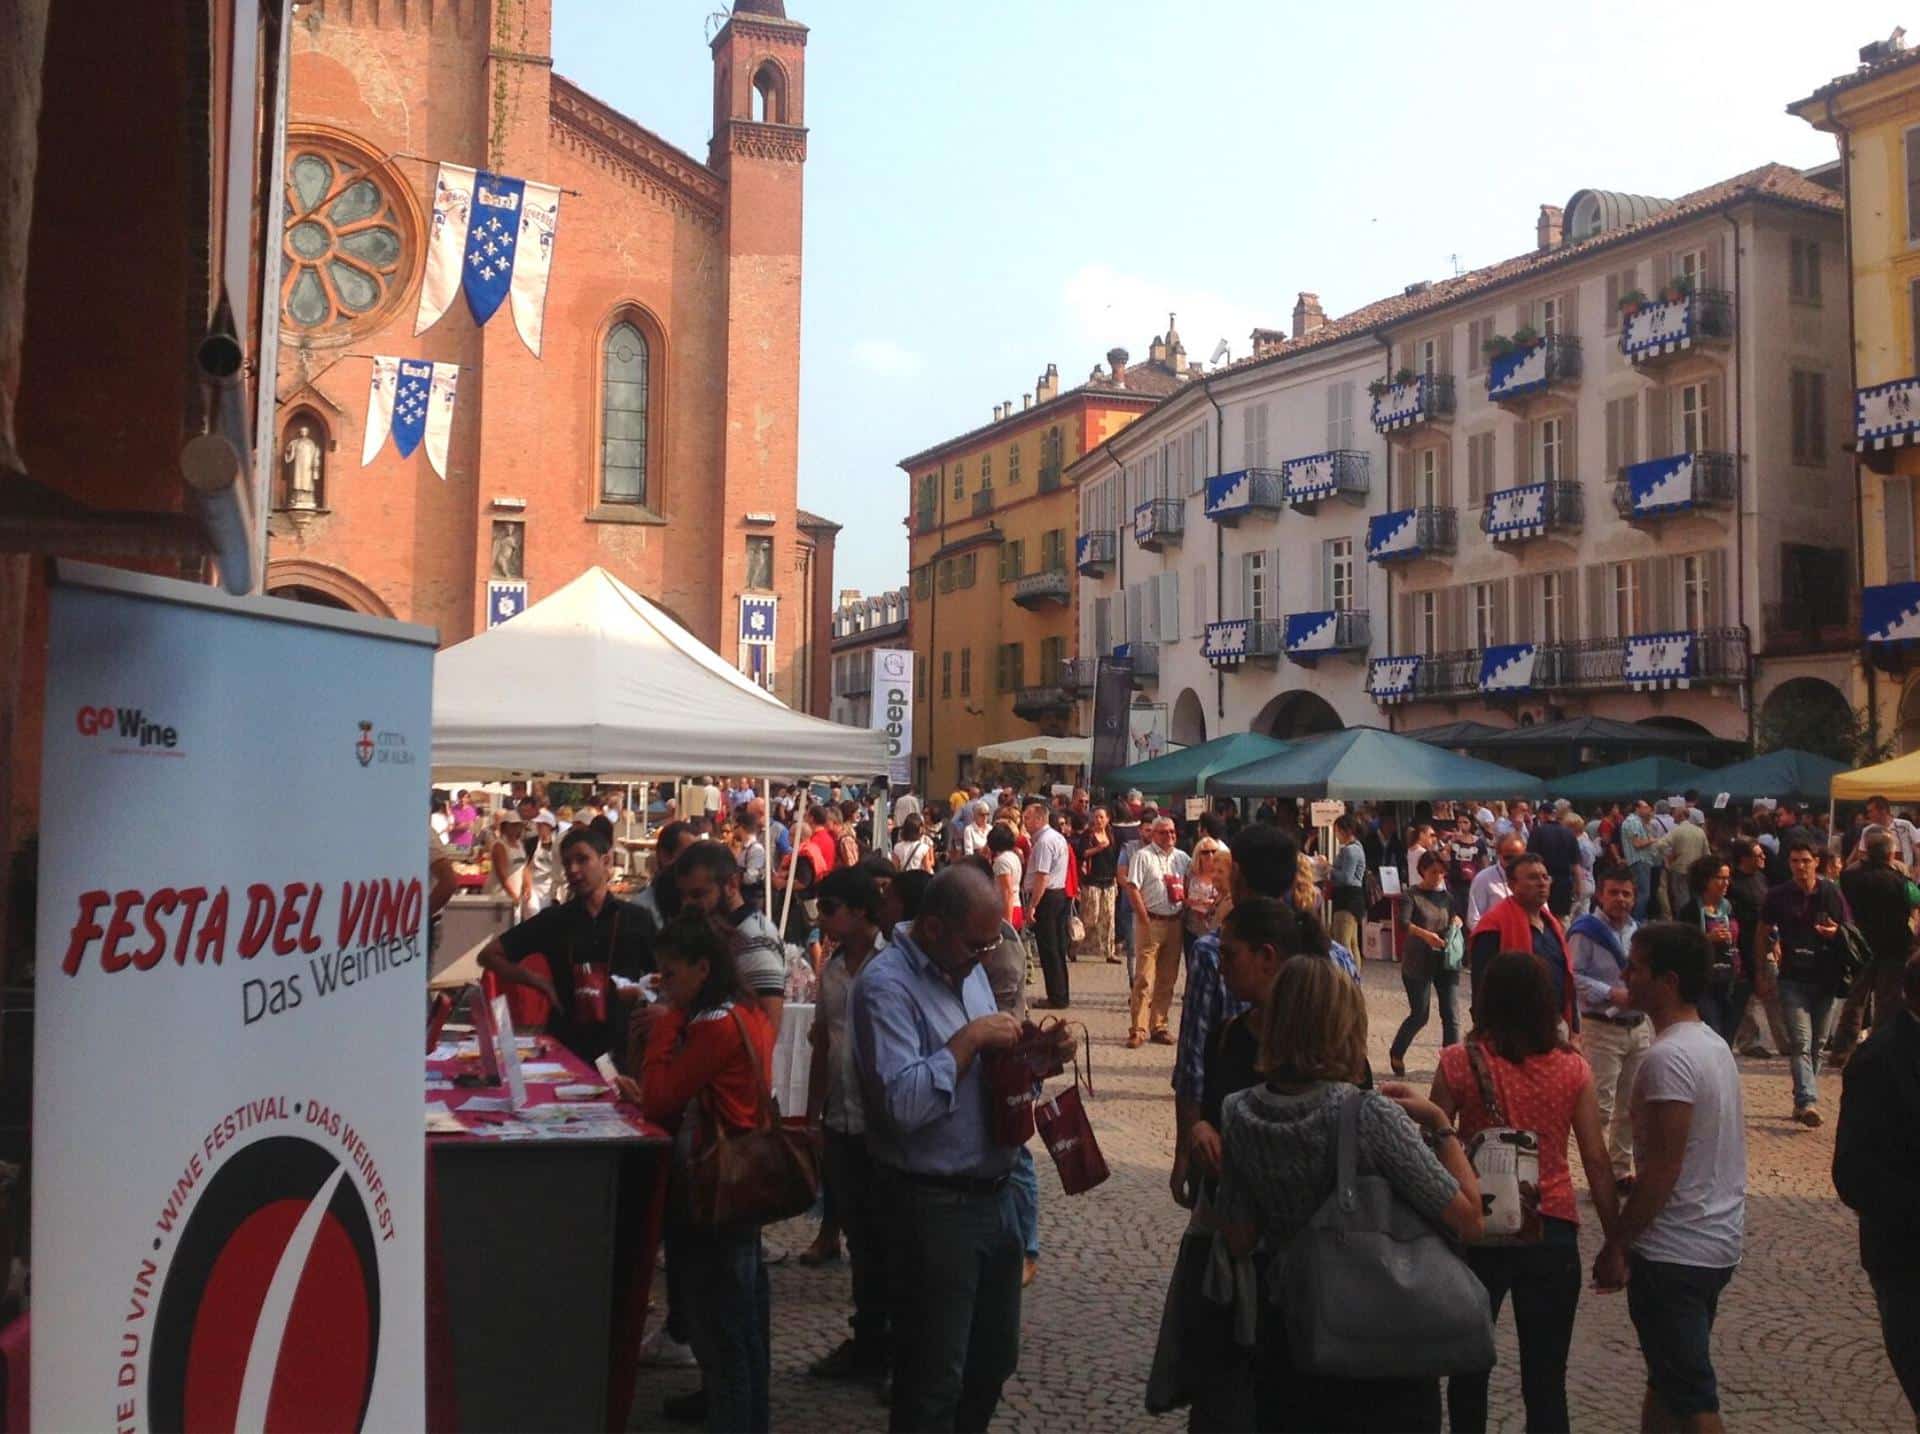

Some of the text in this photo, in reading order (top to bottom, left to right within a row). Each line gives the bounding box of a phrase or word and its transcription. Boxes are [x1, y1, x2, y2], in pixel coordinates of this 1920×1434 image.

[61, 877, 422, 977] FESTA DEL VINO
[242, 929, 421, 1025] Das Weinfest
[204, 1096, 289, 1160] FESTIVAL
[306, 1100, 341, 1136] DAS
[157, 1153, 204, 1232] WINE
[342, 1123, 396, 1241] WEINFEST
[126, 1259, 157, 1322] VIN
[117, 1333, 140, 1387] DU
